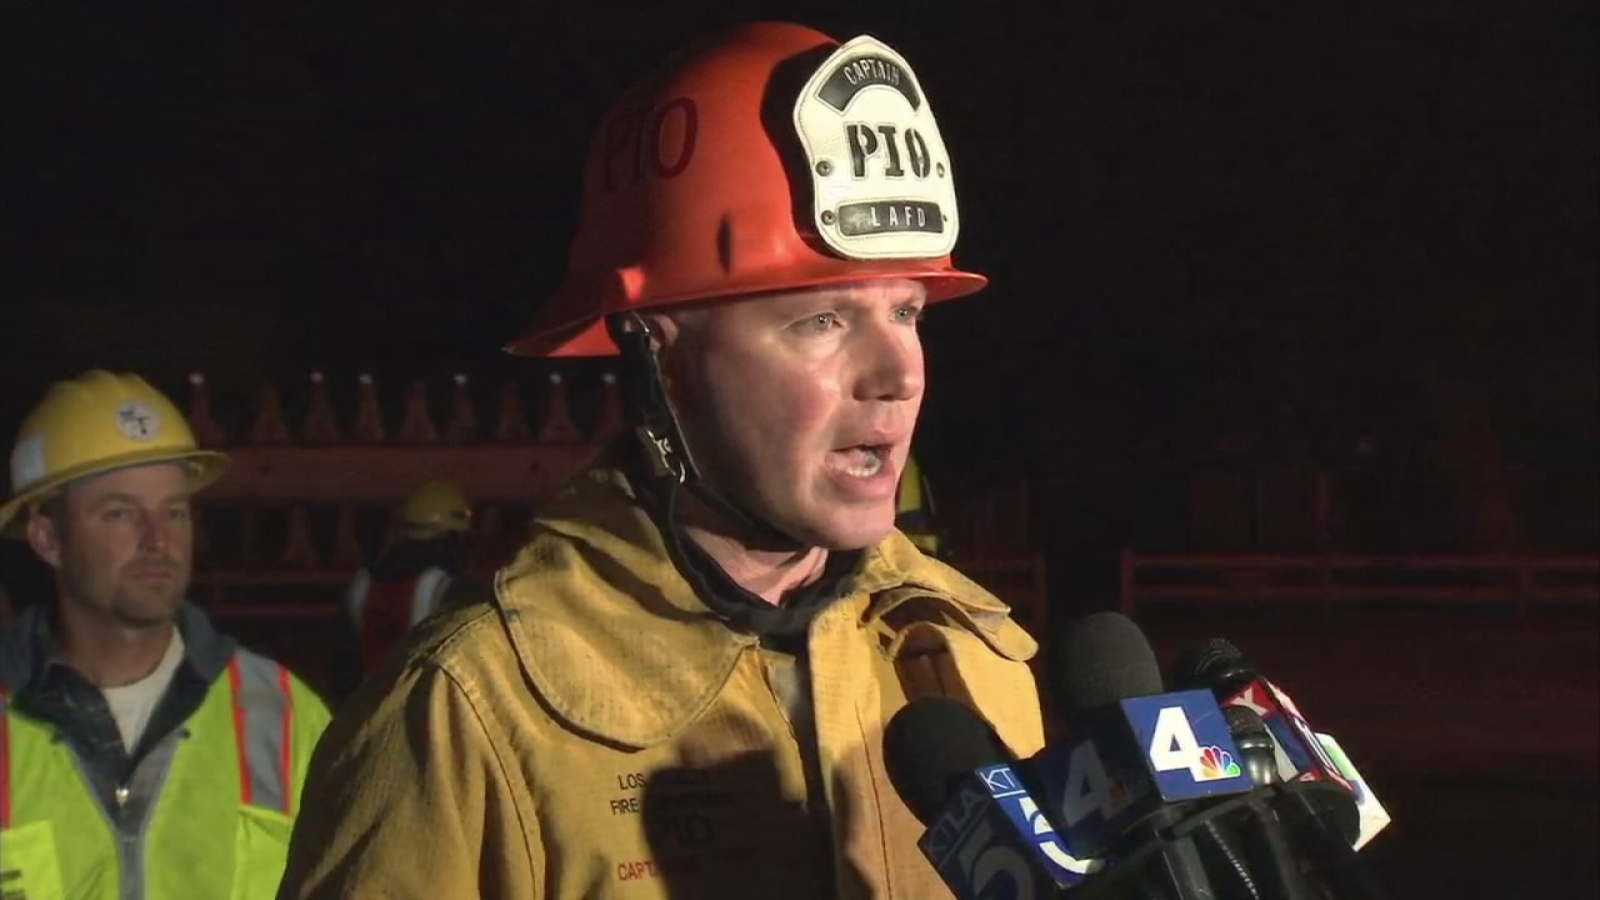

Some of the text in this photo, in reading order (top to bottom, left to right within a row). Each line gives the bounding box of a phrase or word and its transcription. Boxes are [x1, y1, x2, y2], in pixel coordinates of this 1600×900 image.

[843, 58, 900, 86] CAPTAIN
[600, 97, 697, 193] PIO
[845, 124, 931, 178] PIO
[869, 206, 927, 228] LAFD
[1149, 706, 1210, 781] 4
[617, 773, 647, 790] LOS
[609, 798, 640, 815] FIRE
[928, 788, 986, 857] KTLA
